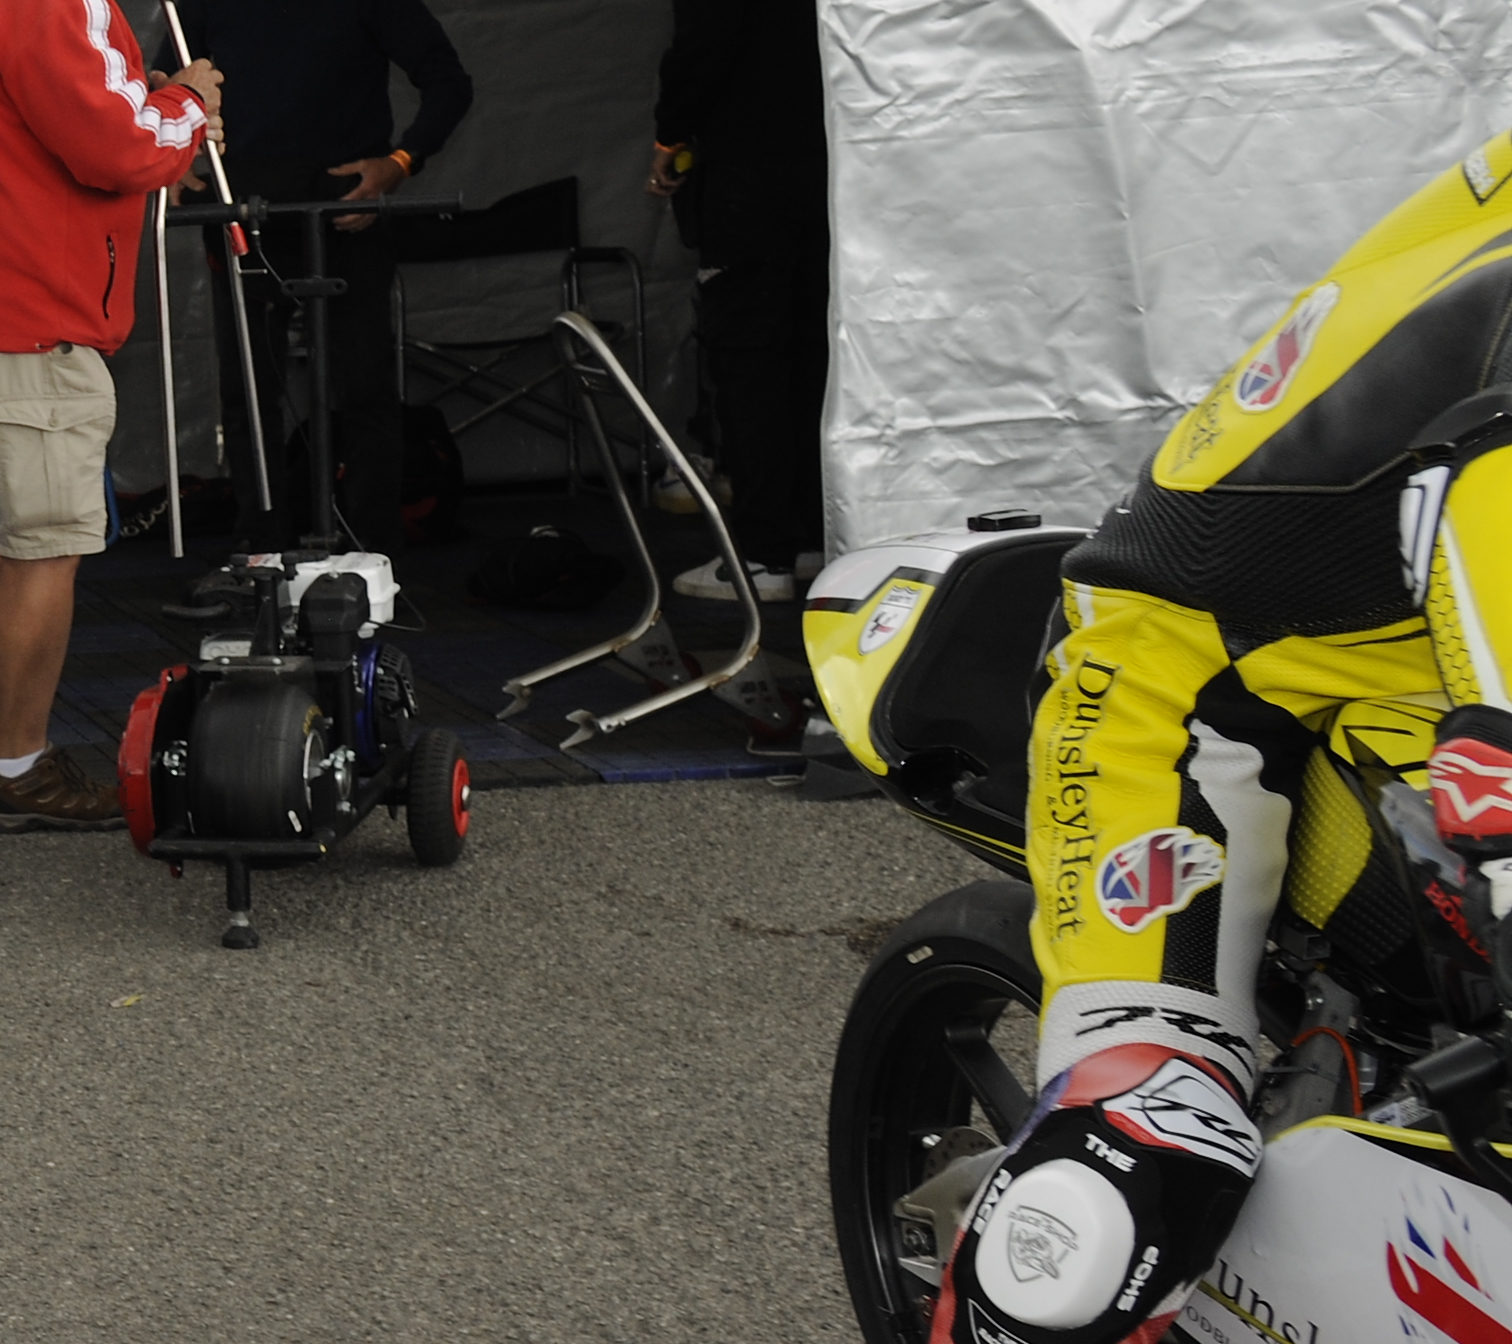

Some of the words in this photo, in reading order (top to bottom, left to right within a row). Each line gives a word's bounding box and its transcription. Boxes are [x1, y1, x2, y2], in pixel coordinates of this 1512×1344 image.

[1083, 1132, 1139, 1173] THE
[971, 1167, 1013, 1237] RACE
[1115, 1244, 1161, 1312] SHOP
